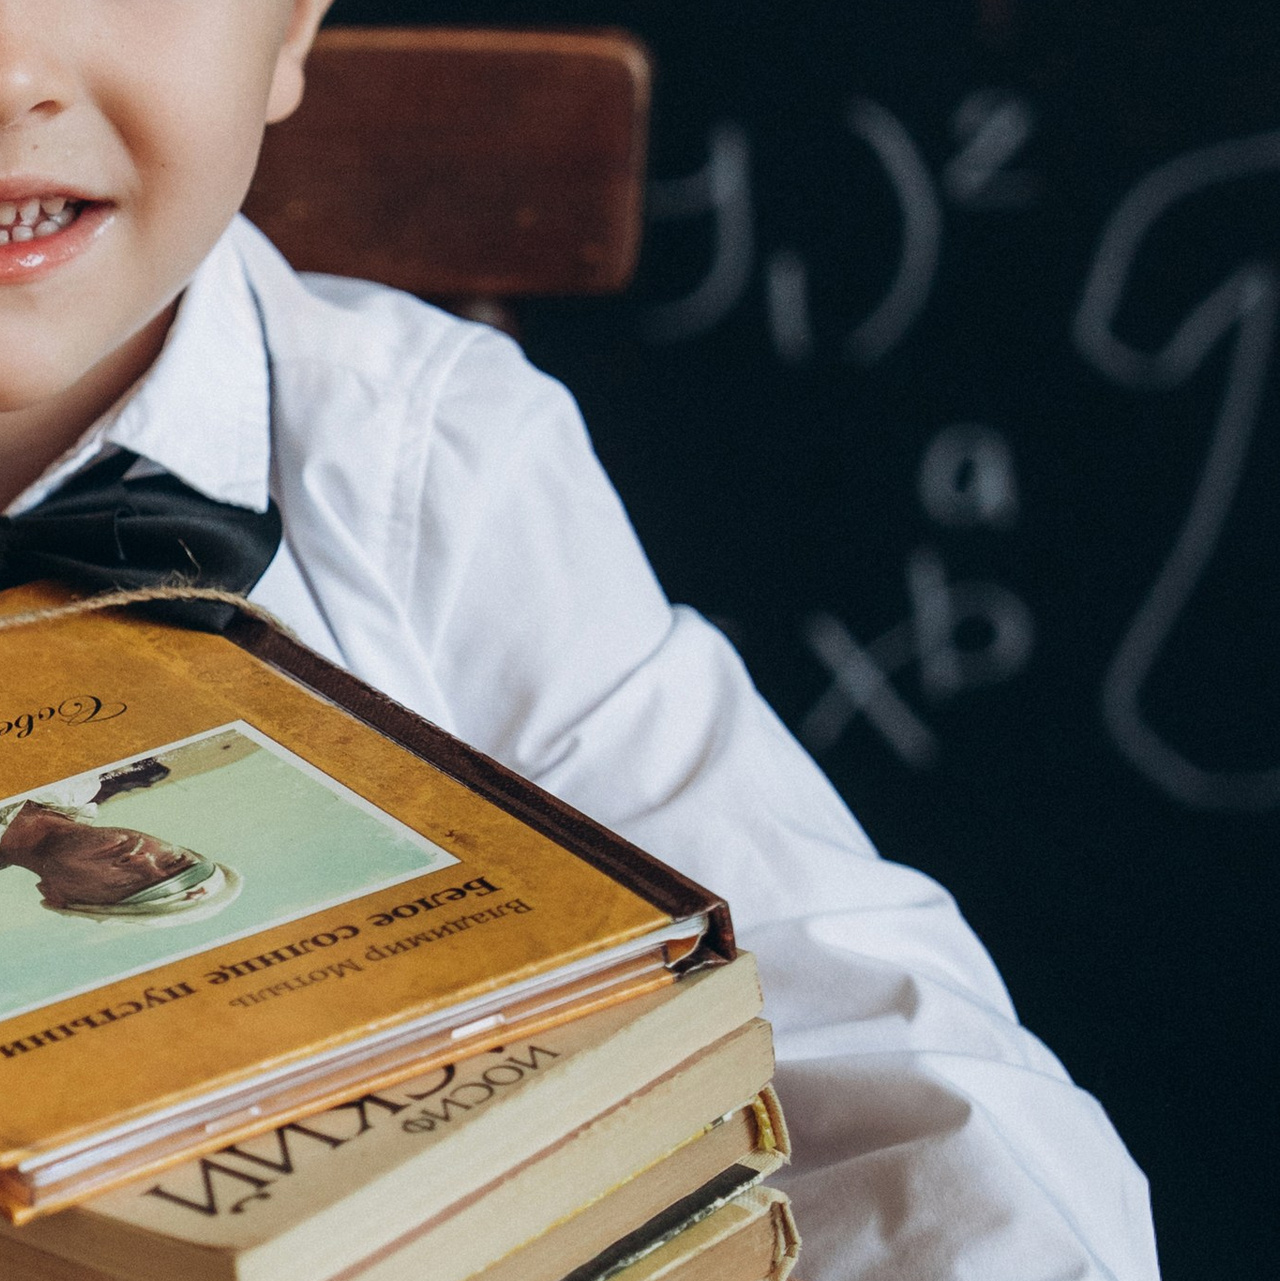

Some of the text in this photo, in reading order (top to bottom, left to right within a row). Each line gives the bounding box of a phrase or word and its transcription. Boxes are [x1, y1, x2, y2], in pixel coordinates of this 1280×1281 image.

[371, 874, 504, 929] Белое
[207, 923, 361, 987] солнце
[227, 896, 535, 1009] Владимир Мотыль
[402, 1043, 562, 1136] ИОСИФ
